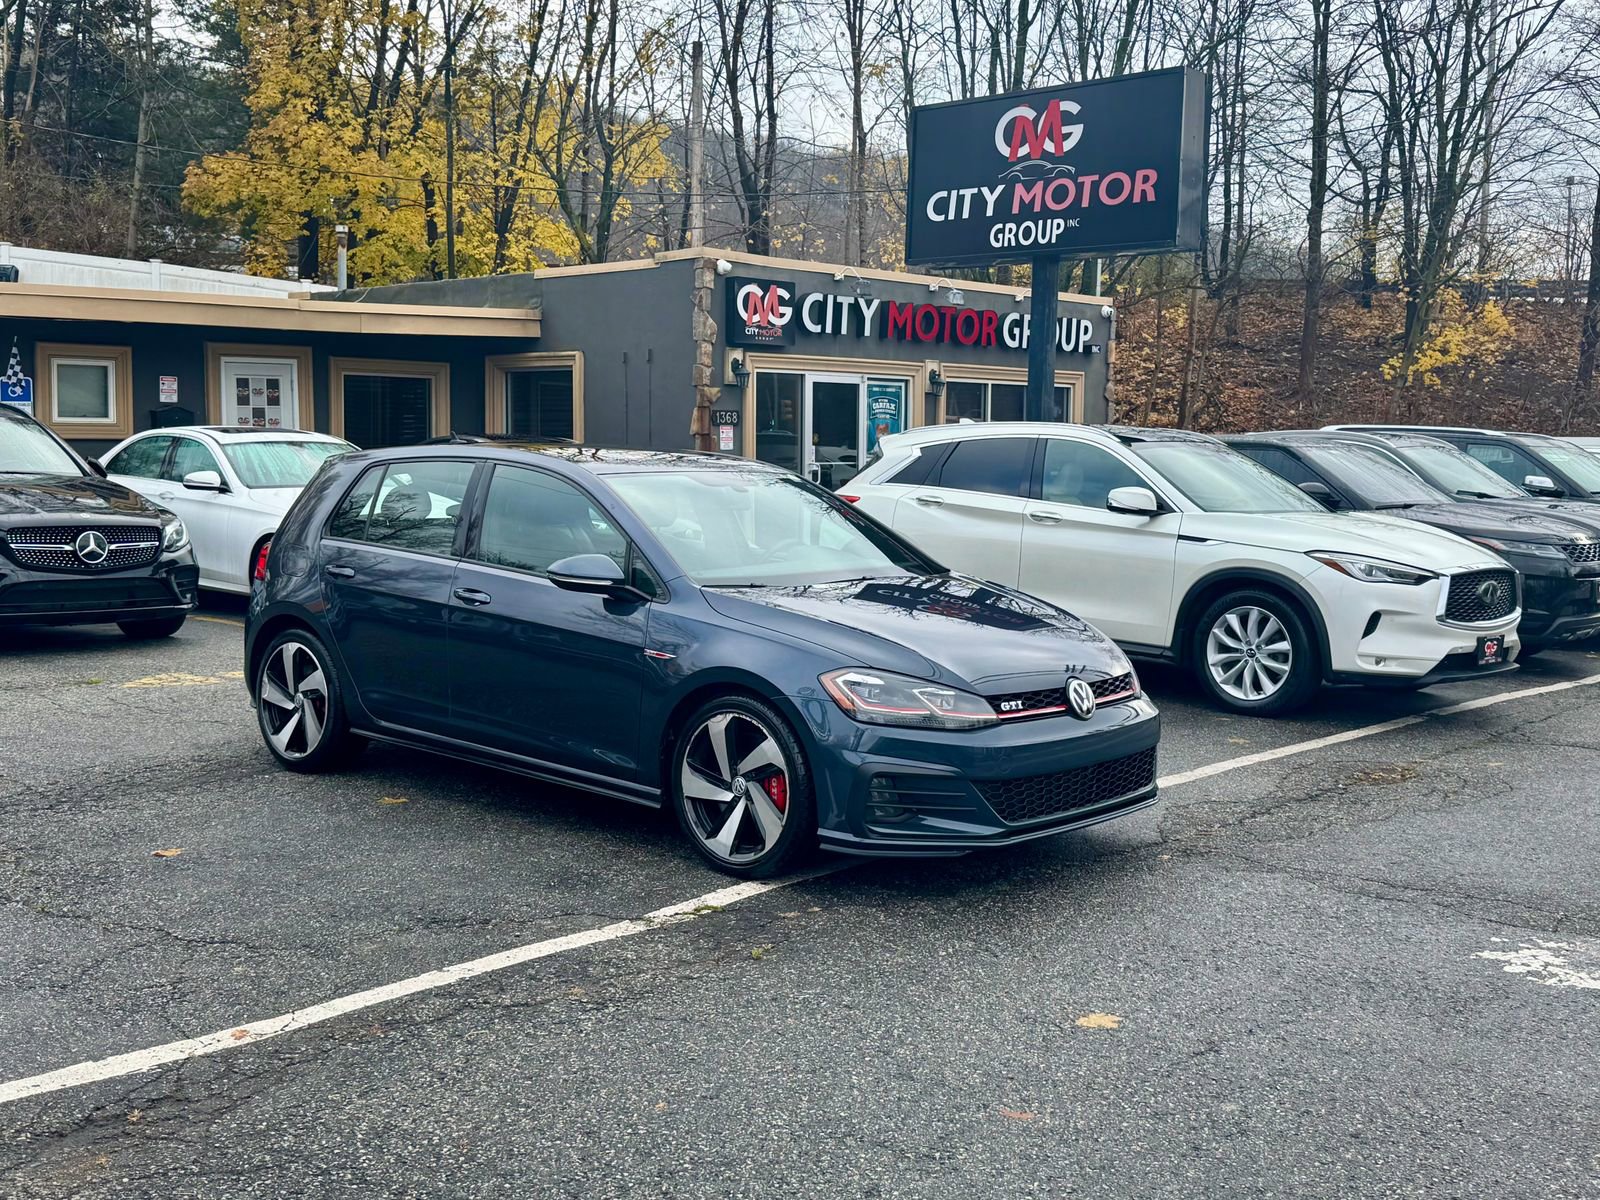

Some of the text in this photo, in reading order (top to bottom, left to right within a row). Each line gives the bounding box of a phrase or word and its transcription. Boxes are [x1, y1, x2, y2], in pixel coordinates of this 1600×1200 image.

[995, 99, 1084, 162] CMG
[926, 169, 1158, 222] CITY MOTOR
[989, 218, 1080, 248] GROUP INC
[745, 327, 759, 335] CITY
[802, 292, 880, 337] CITY
[887, 300, 998, 347] MOTOR
[1003, 312, 1093, 353] GRUP
[716, 411, 738, 423] 1368
[1000, 700, 1024, 711] GTI
